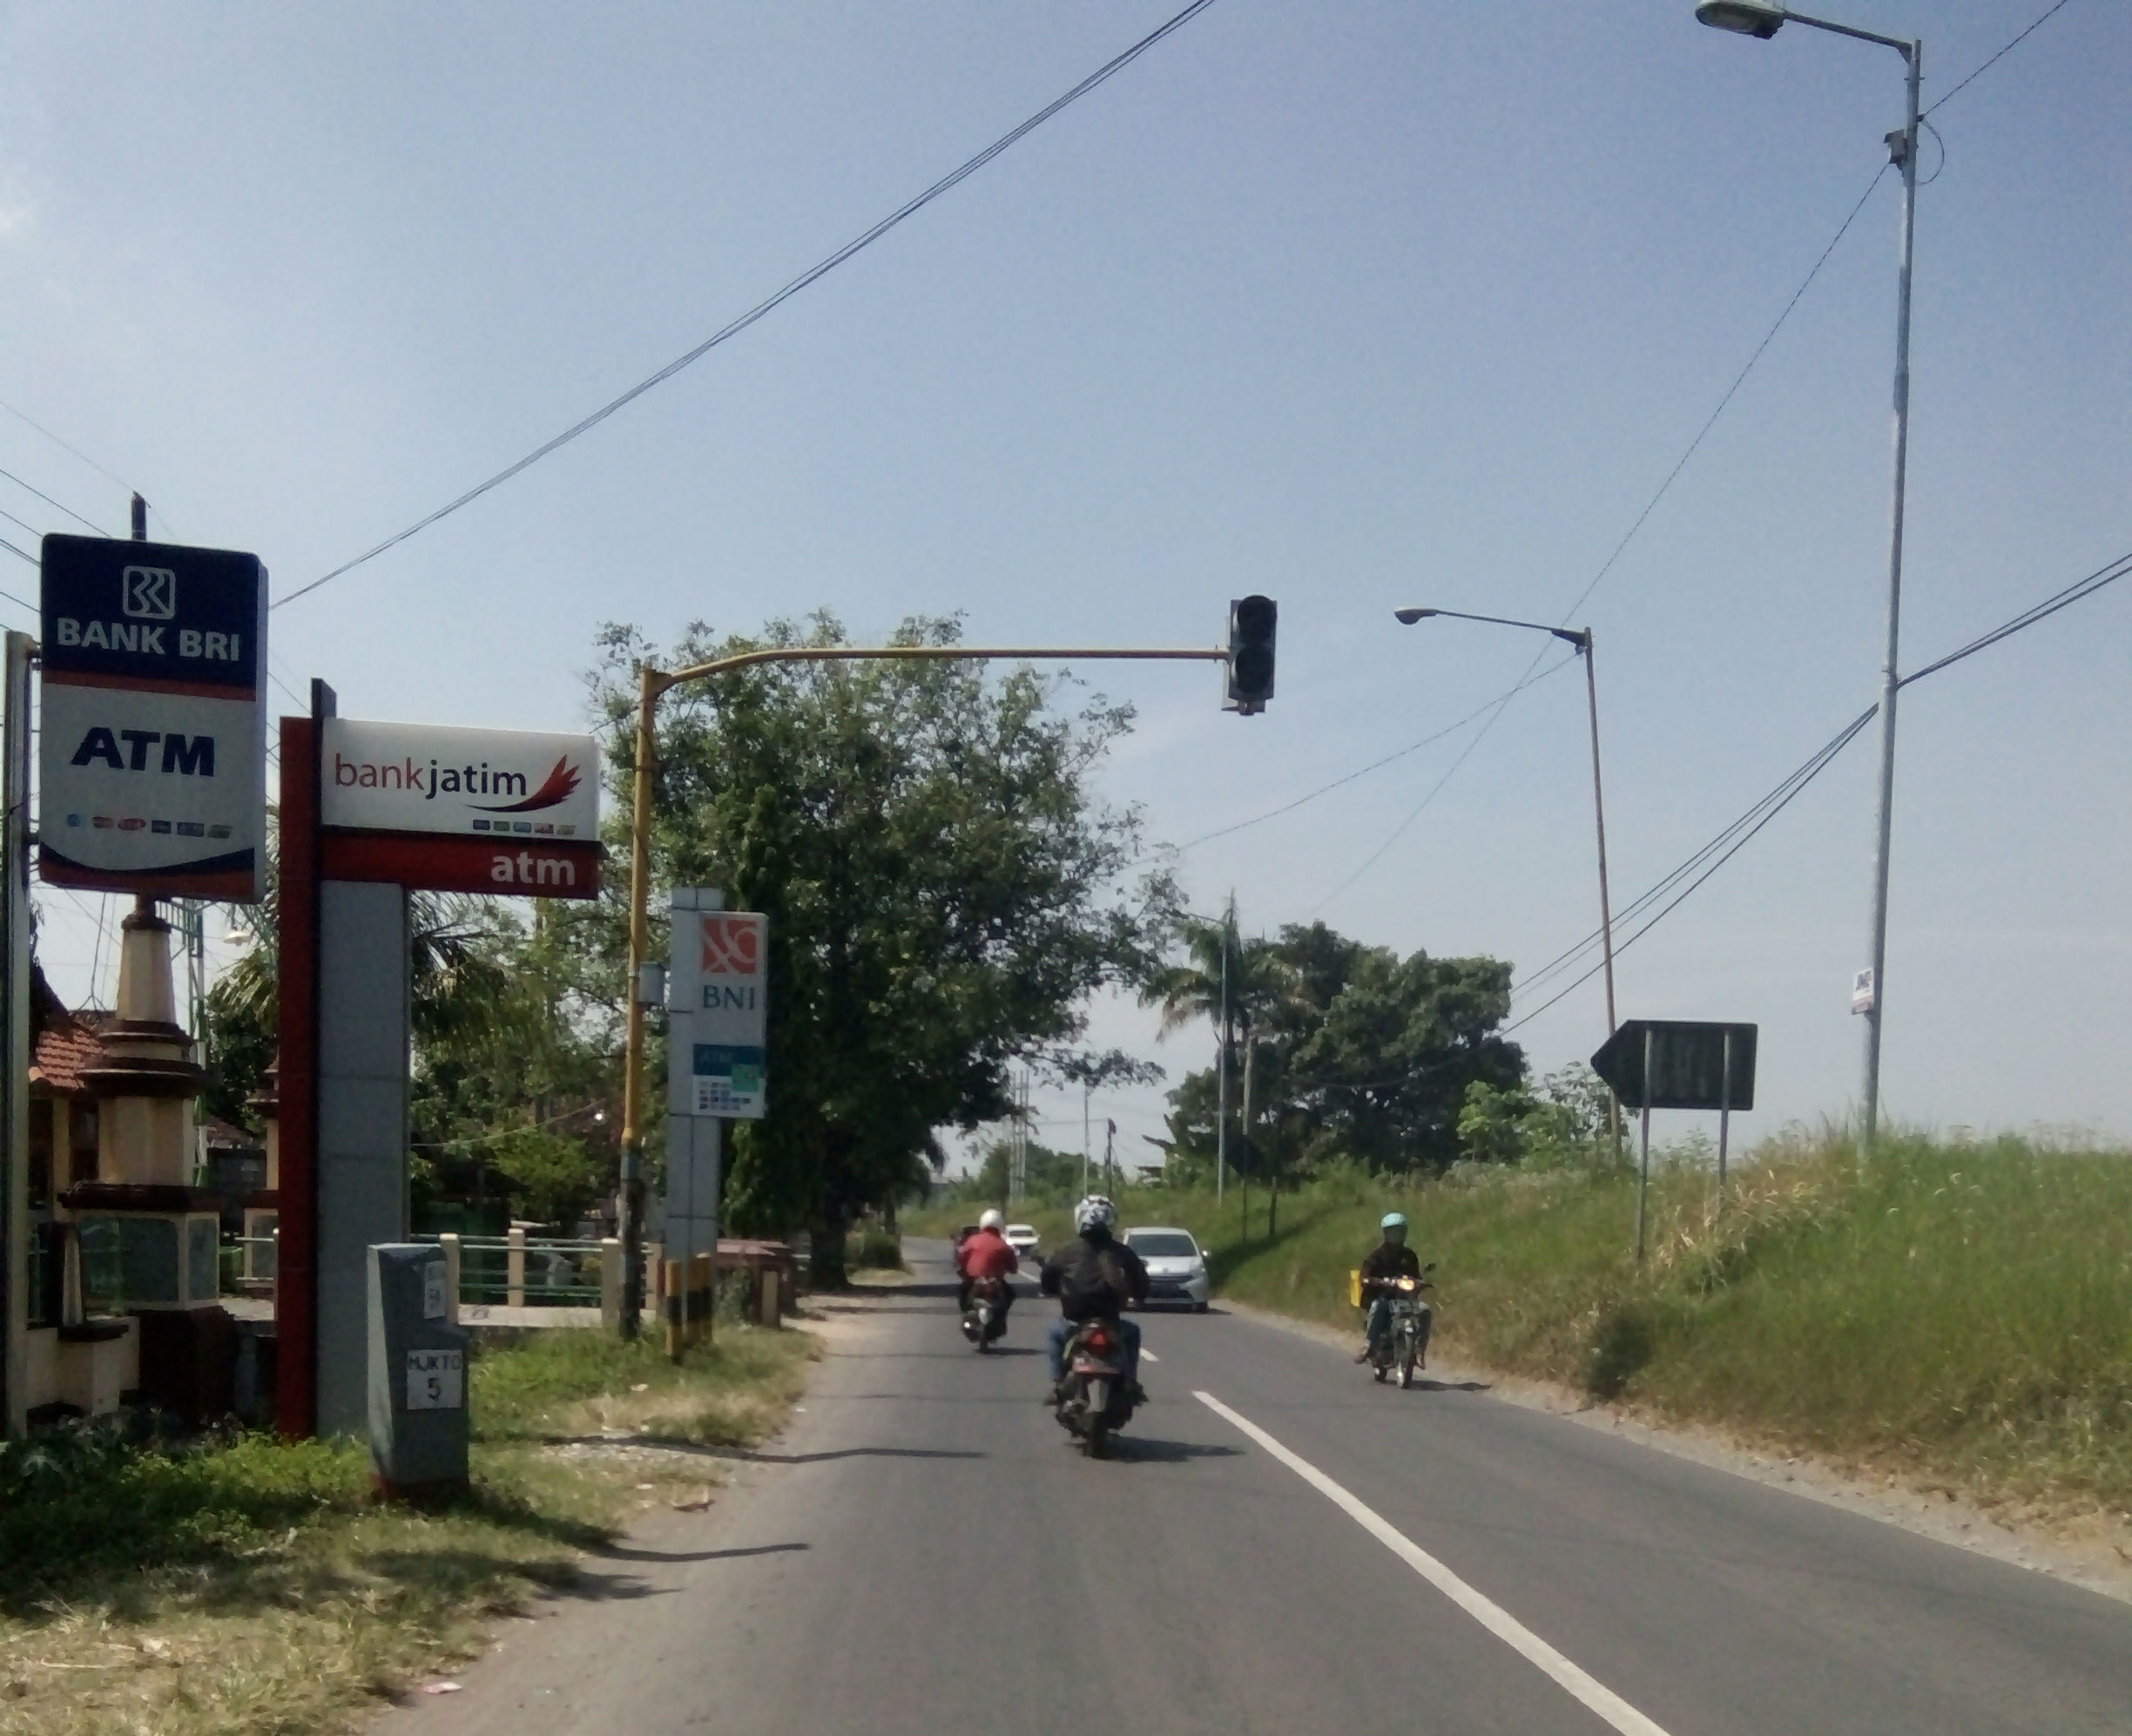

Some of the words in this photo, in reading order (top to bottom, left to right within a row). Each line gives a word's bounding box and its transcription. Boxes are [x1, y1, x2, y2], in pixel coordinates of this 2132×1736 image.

[57, 617, 166, 654] BANK
[179, 629, 240, 661] BRI
[71, 726, 215, 777] ATM
[490, 851, 576, 887] atm
[703, 984, 755, 1010] BNI
[428, 1377, 442, 1402] 5
